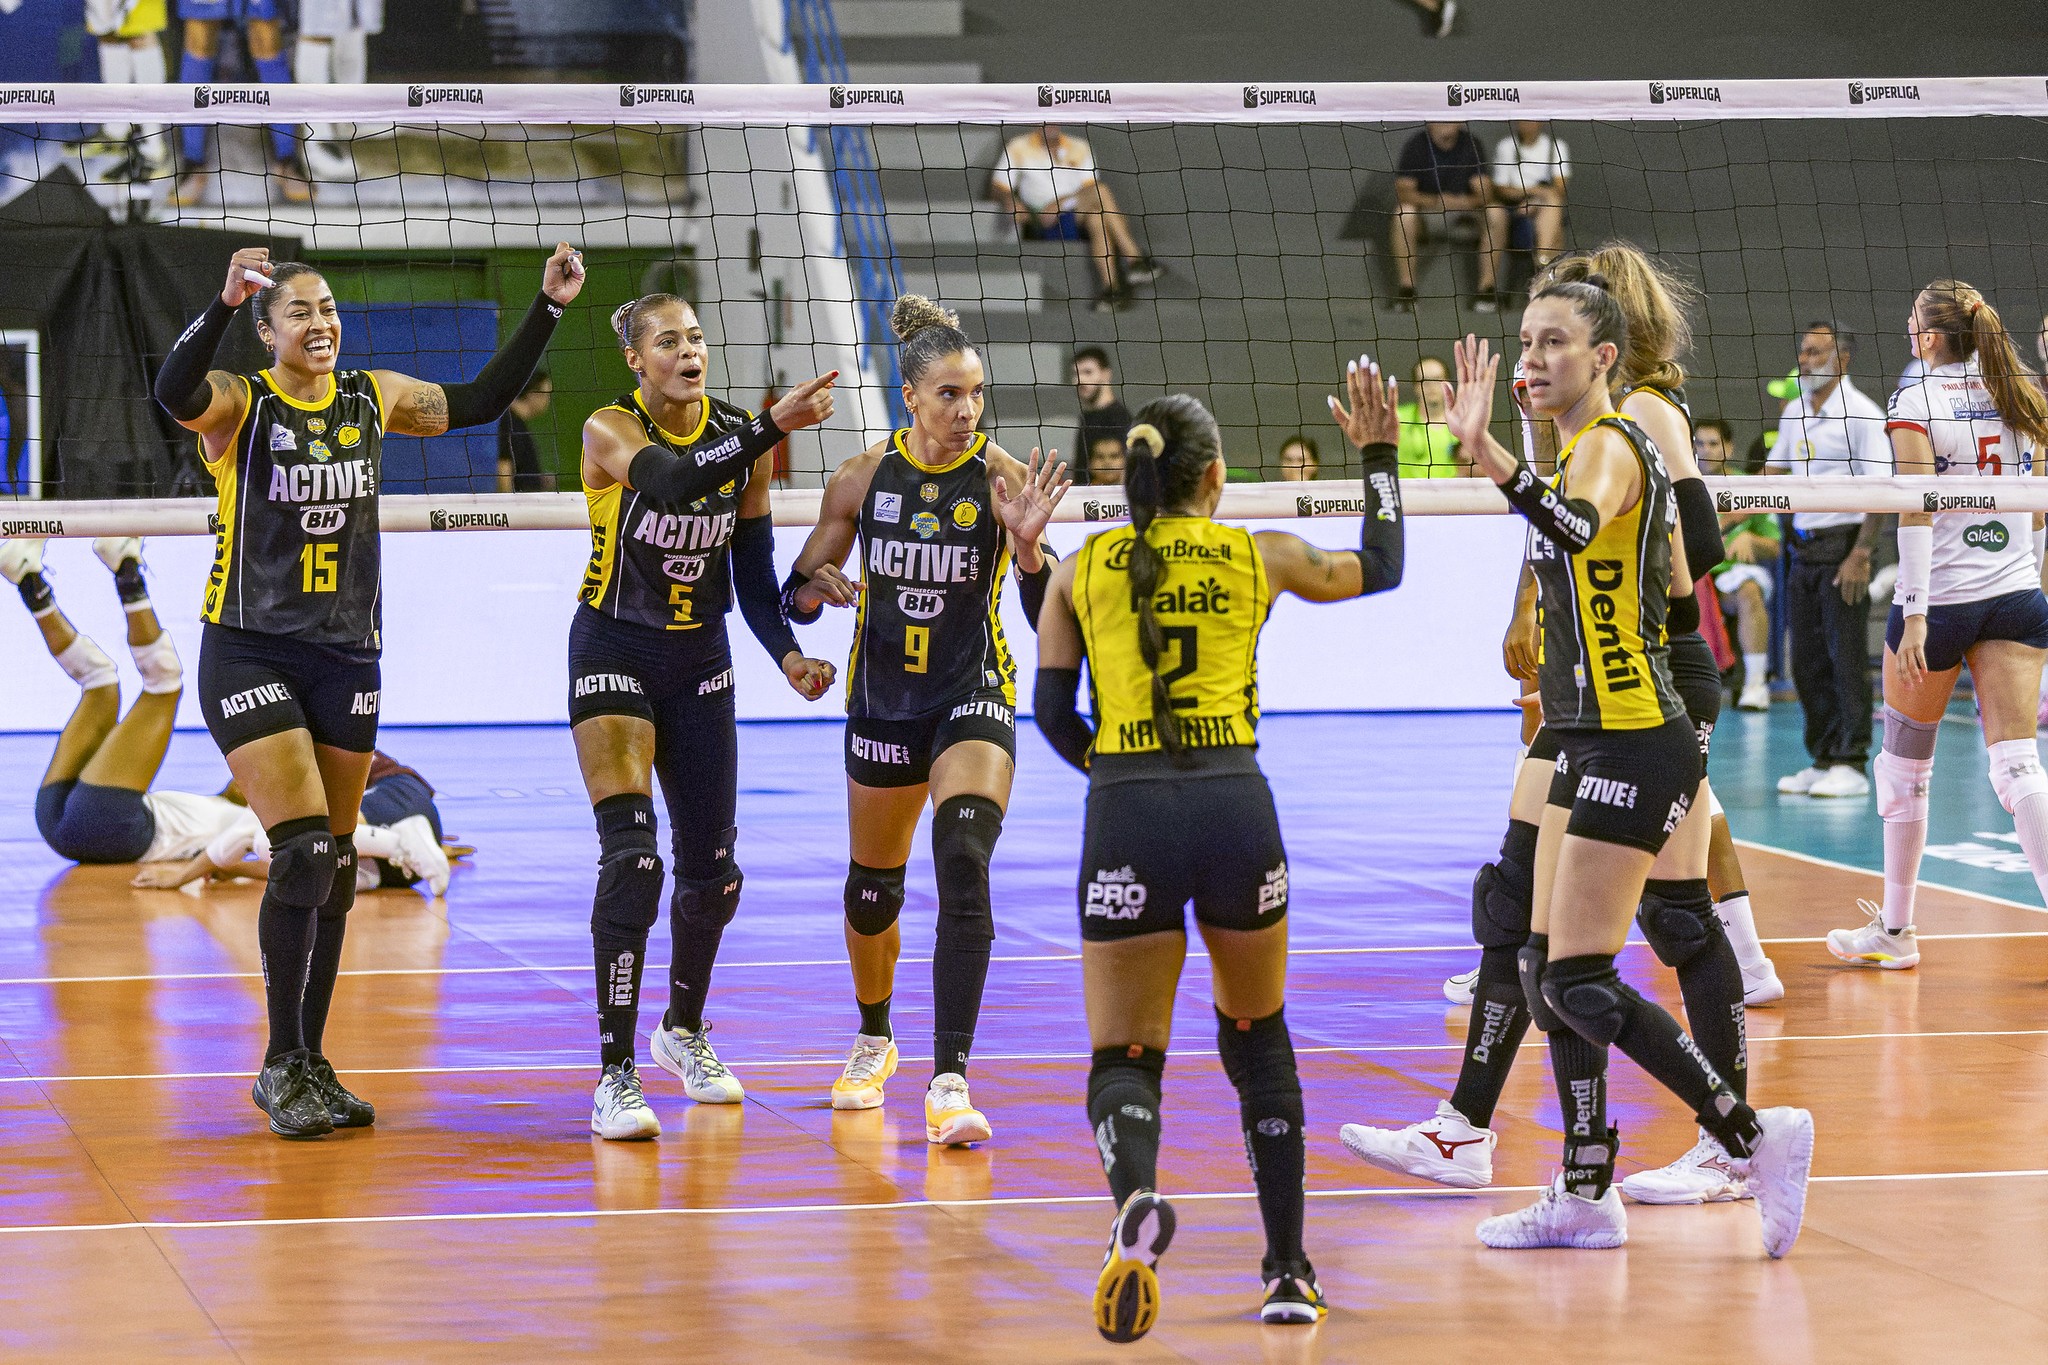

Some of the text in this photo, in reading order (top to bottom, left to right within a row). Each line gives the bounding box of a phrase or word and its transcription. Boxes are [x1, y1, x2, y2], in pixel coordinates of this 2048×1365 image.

[0, 90, 56, 105] SUPERLIGA
[211, 90, 271, 106] SUPERLIGA
[424, 88, 484, 105] SUPERLIGA
[636, 88, 695, 106] SUPERLIGA
[845, 88, 905, 106] SUPERLIGA
[1054, 88, 1112, 106] SUPERLIGA
[1259, 89, 1317, 106] SUPERLIGA
[1463, 88, 1520, 103] SUPERLIGA
[1665, 86, 1721, 103] SUPERLIGA
[1864, 84, 1920, 101] SUPERLIGA
[694, 435, 741, 467] Dentil
[268, 459, 367, 502] ACTIVE
[1101, 503, 1129, 519] SUPE
[1314, 499, 1365, 514] SUPERLIG
[1733, 495, 1791, 510] SUPERLIGA
[1940, 495, 1996, 510] SUPERLIGA
[306, 511, 339, 529] BH
[448, 512, 510, 529] SUPERLIGA
[1540, 488, 1591, 540] Dentil
[1, 520, 65, 537] SUPERLIGA
[633, 509, 732, 551] ACTIVE
[1966, 530, 2005, 543] alelo
[299, 543, 339, 593] 15
[668, 561, 701, 577] BH
[869, 537, 968, 583] ACTIVE
[896, 584, 947, 595] SUPERMERCADOS
[668, 583, 694, 622] 5
[904, 593, 937, 613] BH
[1586, 559, 1642, 693] Dentil
[904, 624, 930, 674] 9
[1157, 625, 1199, 709] 2
[575, 673, 639, 698] ACTIVE
[698, 667, 734, 696] ACTI
[220, 682, 286, 719] ACTIVE
[350, 689, 381, 715] ACTI
[950, 701, 1014, 729] ACTIVE
[851, 733, 903, 765] ACTIVE
[1576, 774, 1629, 808] CTIVE
[634, 811, 647, 824] N1
[959, 807, 976, 819] N1
[313, 841, 328, 855] N1
[715, 847, 727, 860] N1
[337, 854, 351, 869] N1
[637, 856, 656, 870] N1
[723, 880, 738, 895] N1
[861, 889, 878, 902] N1
[1086, 882, 1147, 906] PRO
[614, 951, 635, 1006] entil
[1472, 1000, 1507, 1064] Dentil
[1570, 1078, 1591, 1136] Dentil
